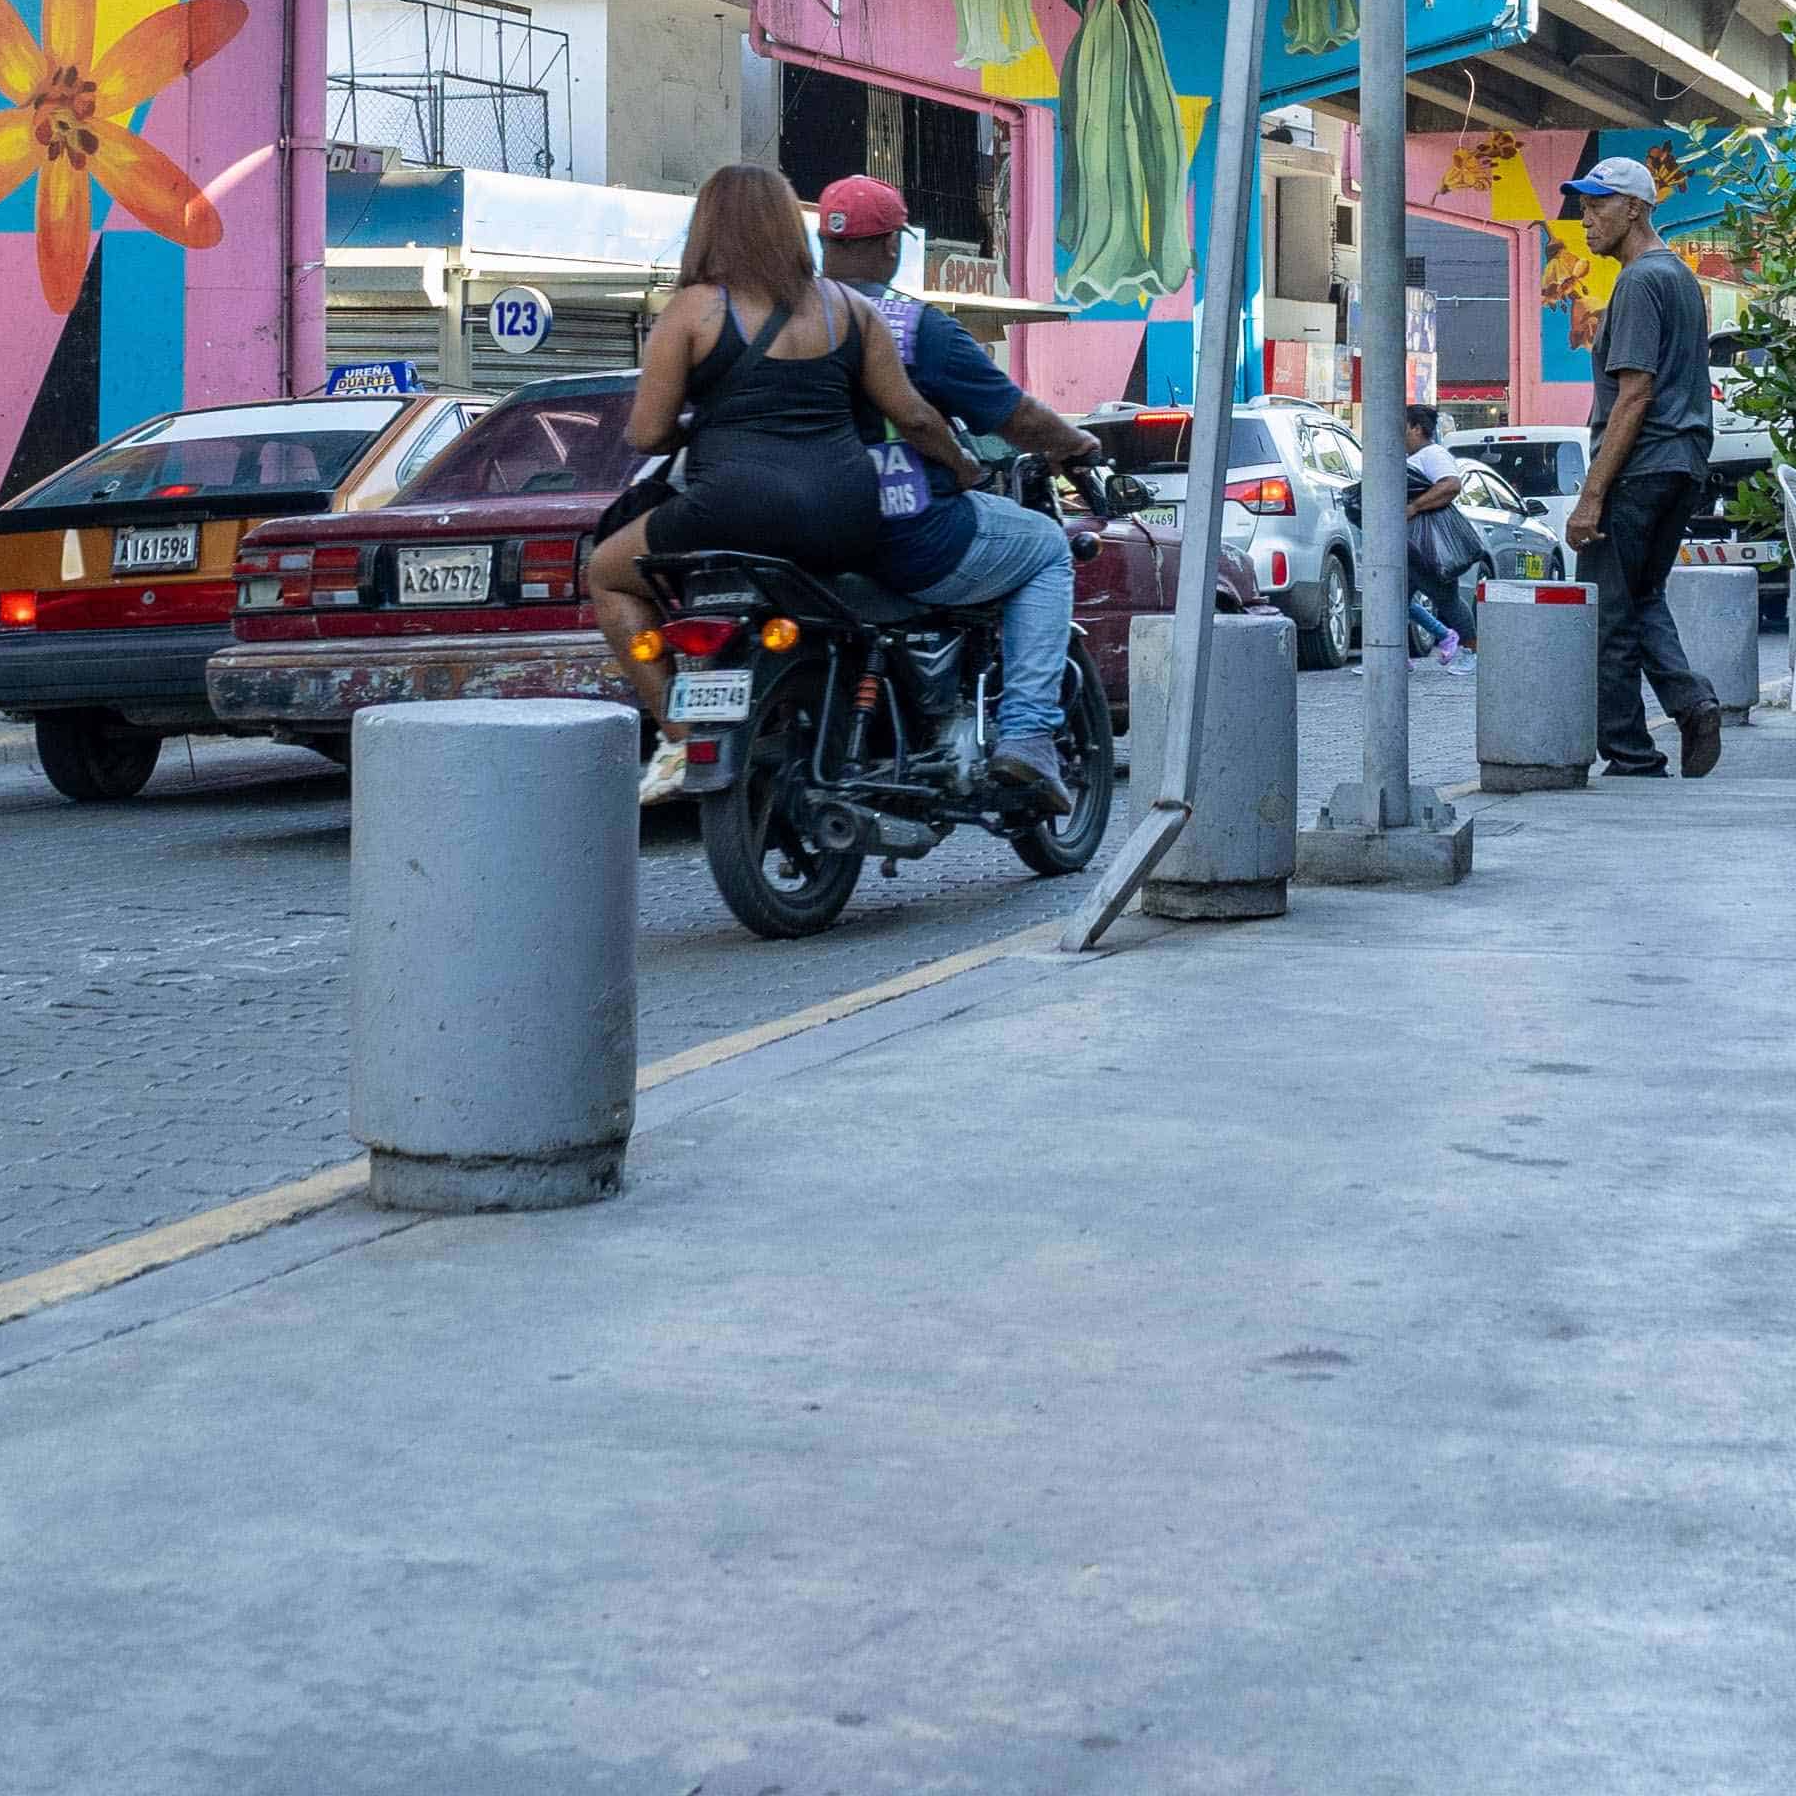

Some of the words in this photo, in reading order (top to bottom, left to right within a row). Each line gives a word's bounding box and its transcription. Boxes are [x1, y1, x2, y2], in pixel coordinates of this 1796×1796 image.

[946, 260, 997, 295] SPORT
[496, 301, 538, 336] 123
[338, 375, 395, 389] DUARTE
[345, 365, 392, 378] UREÑA
[879, 483, 918, 516] RIS
[405, 565, 481, 593] A267572
